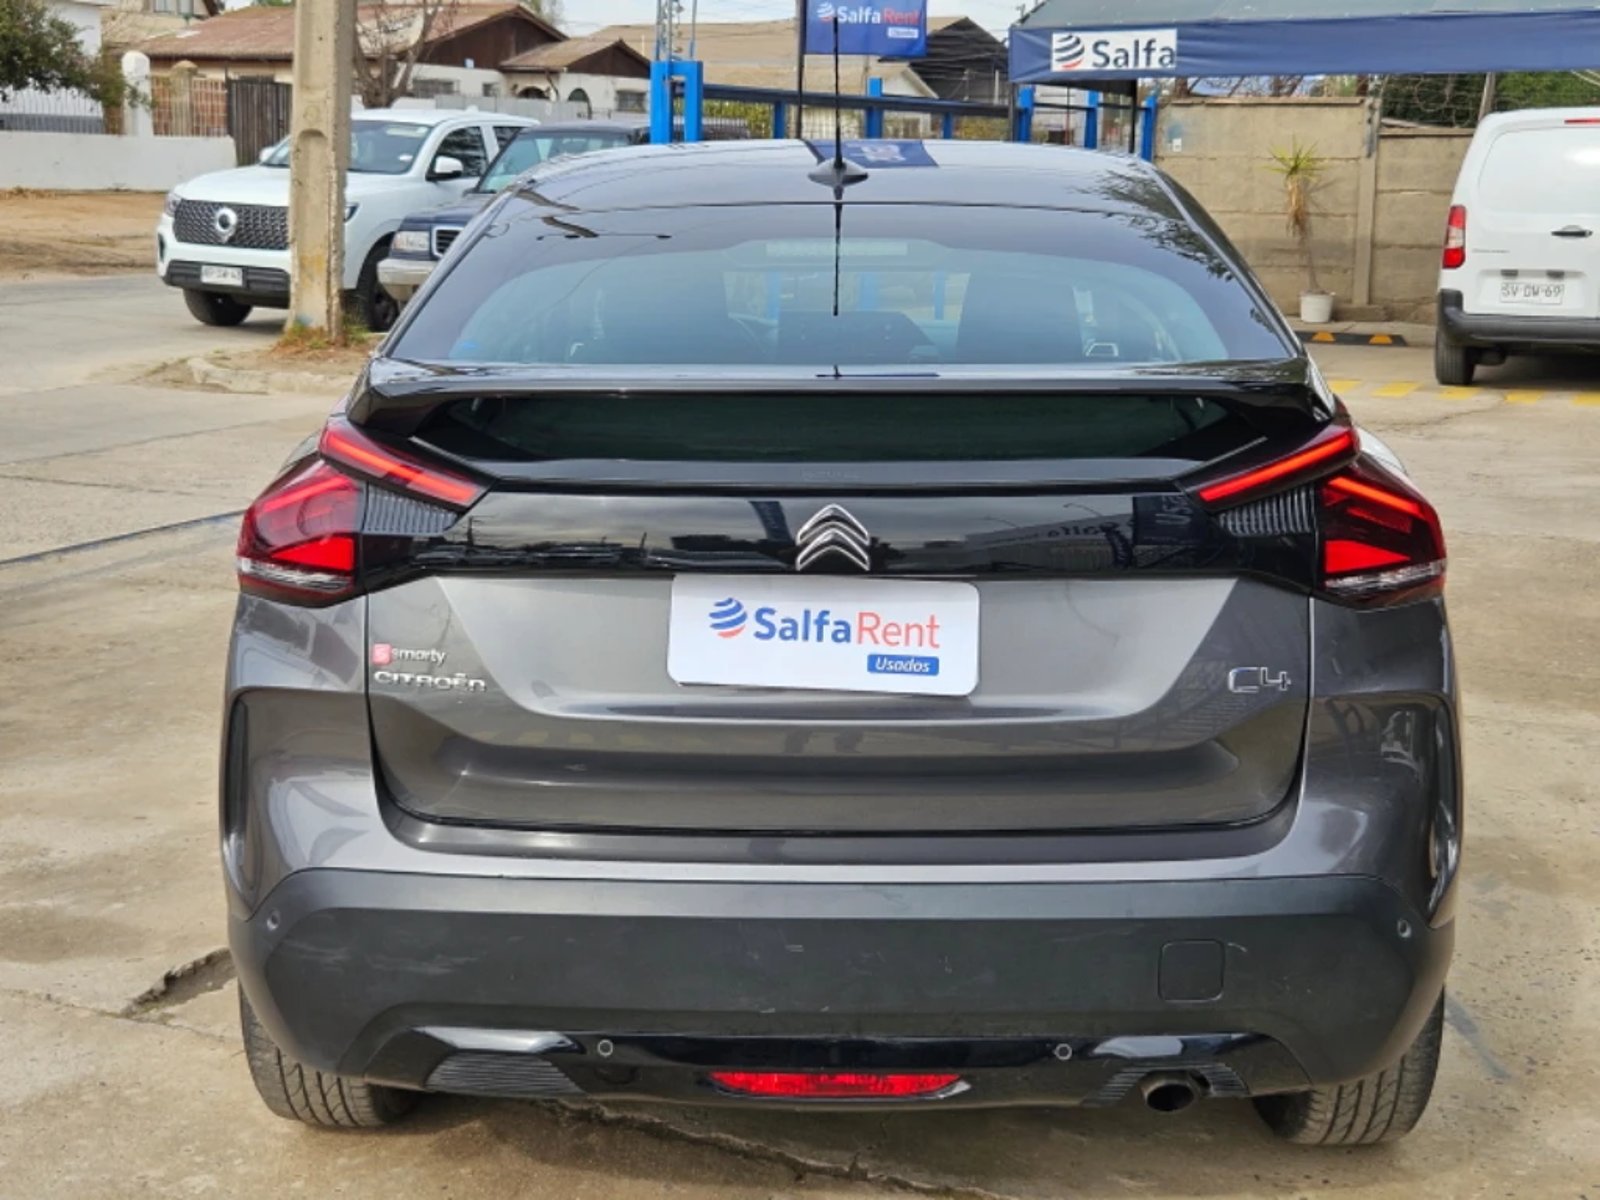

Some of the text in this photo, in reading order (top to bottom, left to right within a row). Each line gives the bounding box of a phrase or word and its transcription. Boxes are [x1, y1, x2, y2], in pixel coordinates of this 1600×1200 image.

[1092, 38, 1176, 69] Salfa
[875, 656, 931, 673] Usados
[1228, 666, 1292, 693] C4
